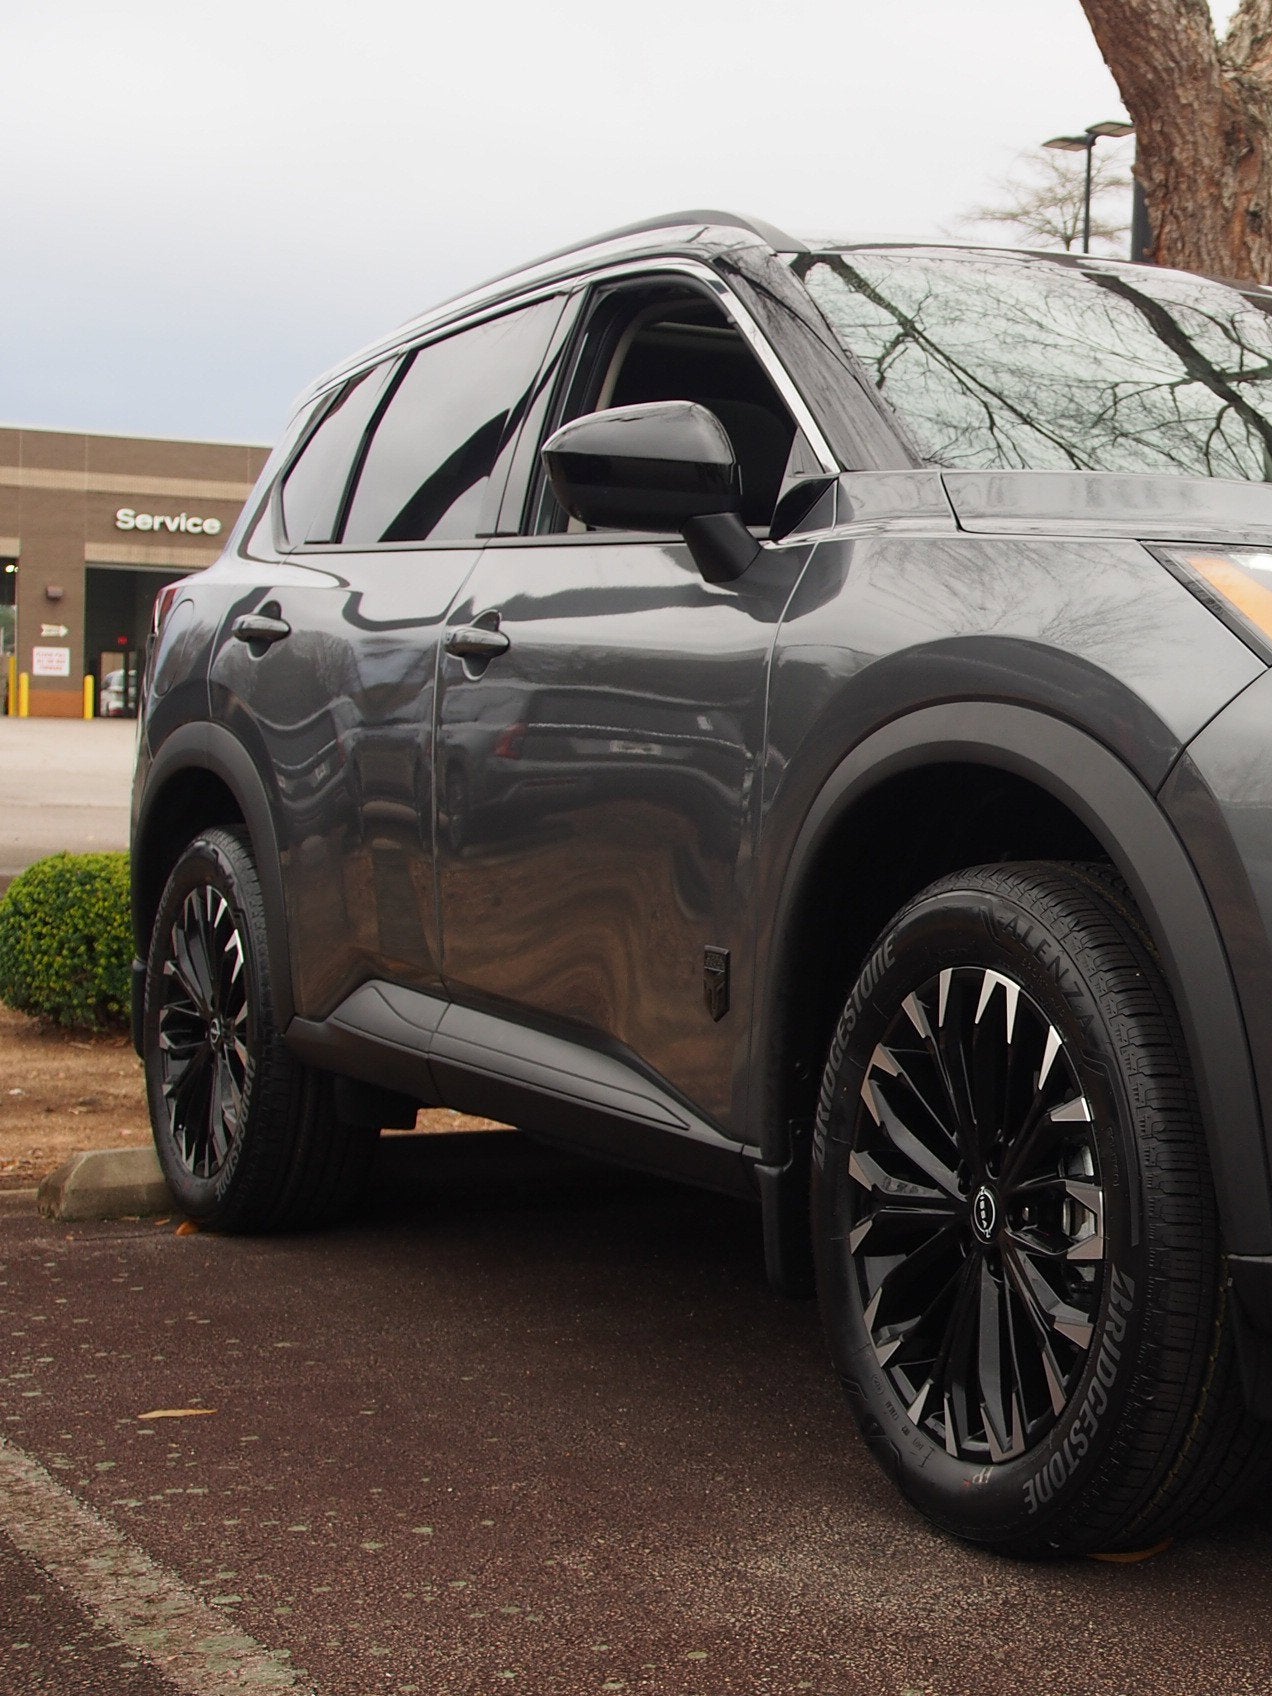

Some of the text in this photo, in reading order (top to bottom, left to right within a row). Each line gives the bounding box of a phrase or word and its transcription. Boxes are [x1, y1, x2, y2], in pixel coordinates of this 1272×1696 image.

[115, 507, 221, 535] Service
[812, 932, 896, 1171] BRIDGESTONE
[1022, 1262, 1136, 1515] BRIDGESTONE
